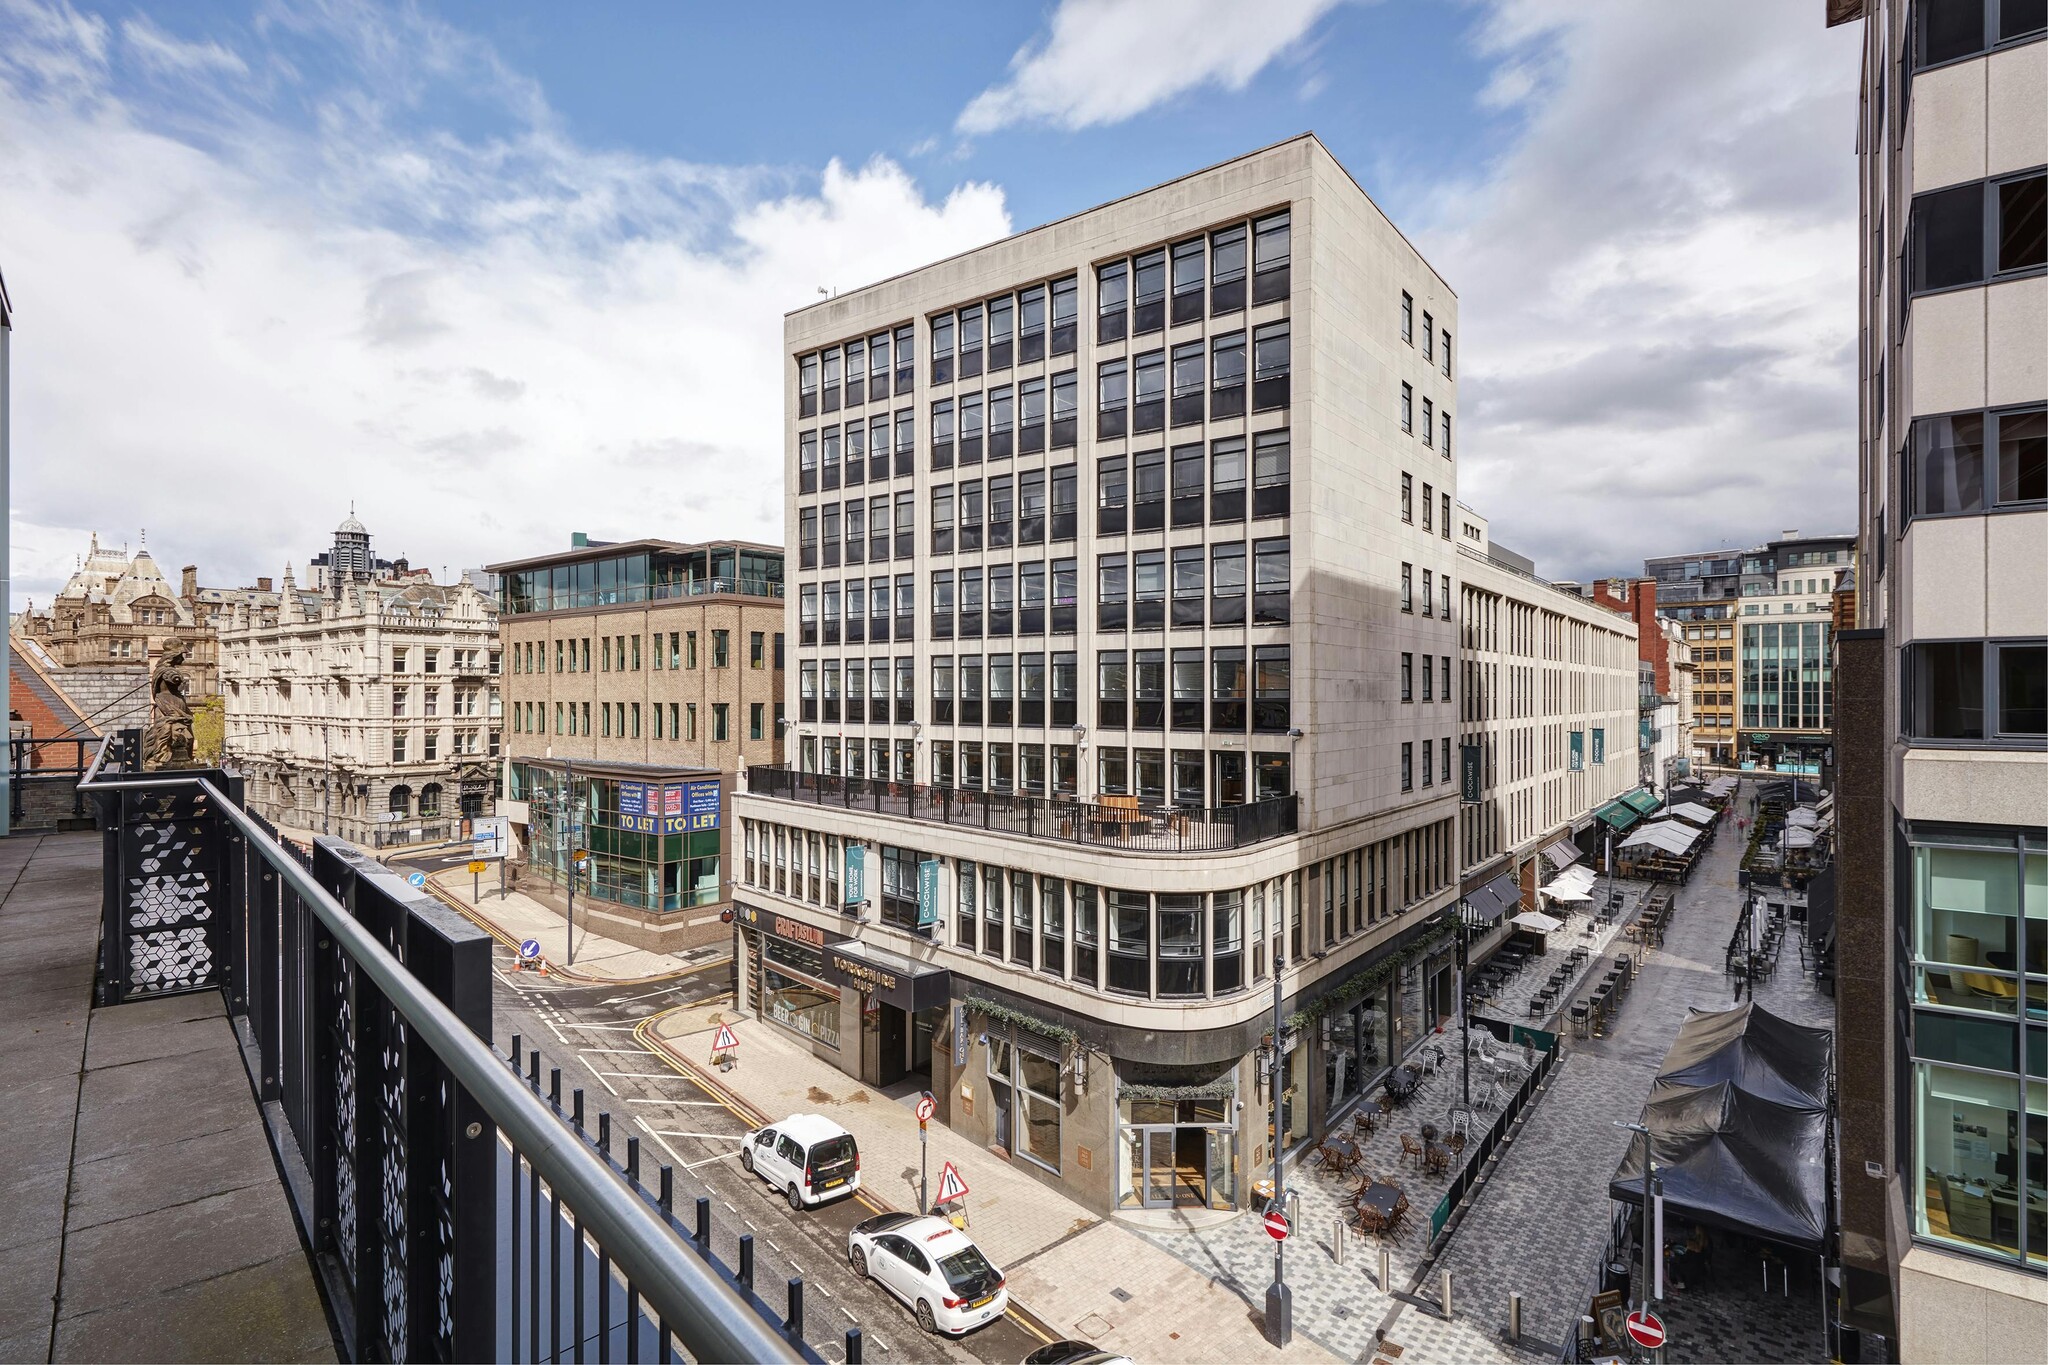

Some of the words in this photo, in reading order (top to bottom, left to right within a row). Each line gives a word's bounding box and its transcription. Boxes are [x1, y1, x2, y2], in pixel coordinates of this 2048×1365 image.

[621, 815, 634, 828] TO
[637, 817, 654, 831] LET
[665, 817, 687, 831] TO
[693, 814, 716, 828] LET
[833, 956, 896, 989] YORKSHIRE
[773, 1003, 790, 1024] BEER
[798, 1014, 811, 1034] GIN
[820, 1025, 840, 1048] PIZZA
[929, 1229, 953, 1241] TAXI
